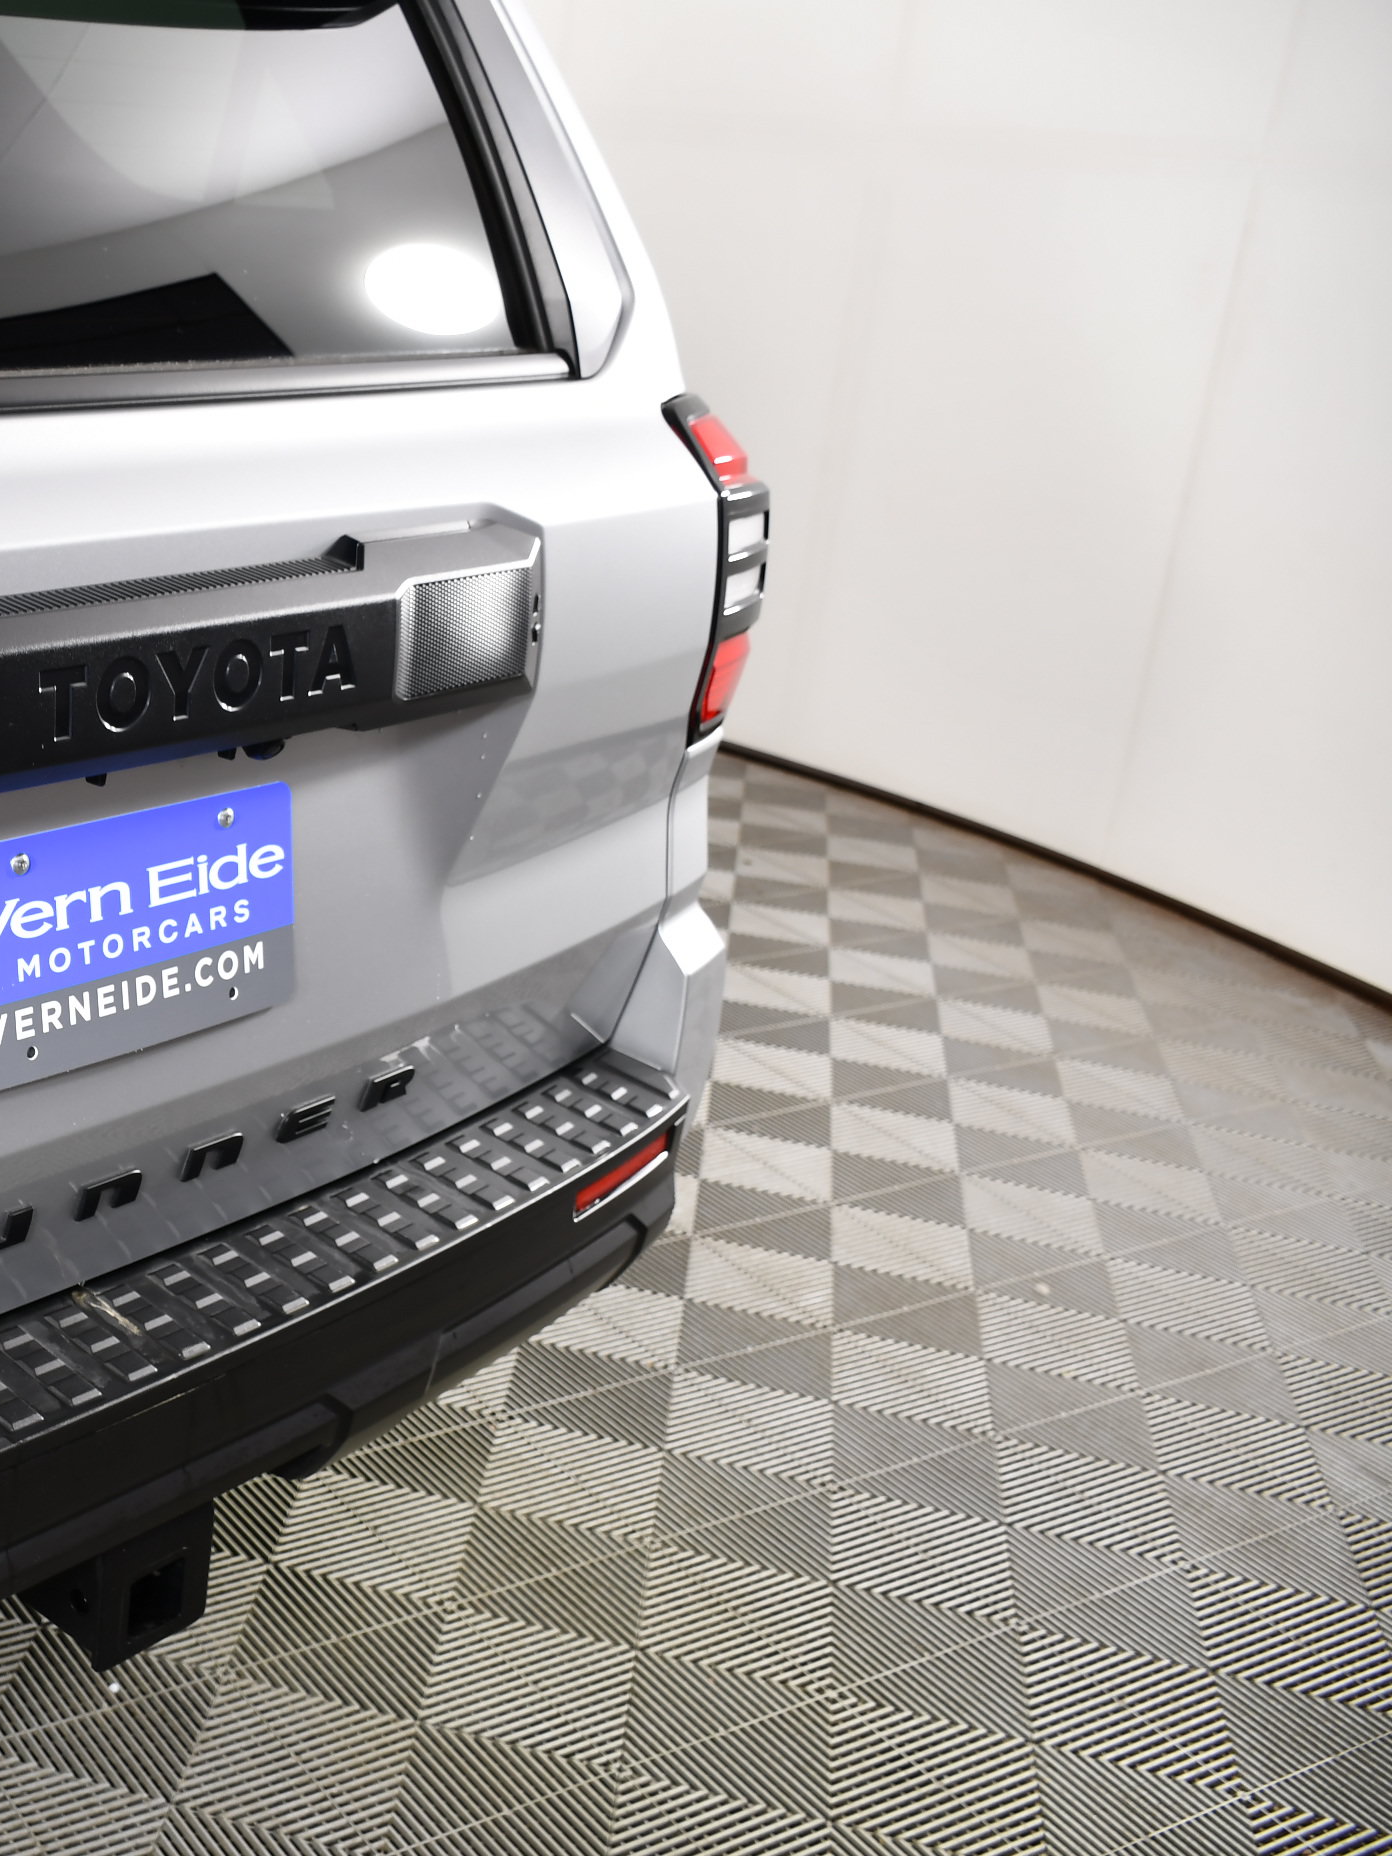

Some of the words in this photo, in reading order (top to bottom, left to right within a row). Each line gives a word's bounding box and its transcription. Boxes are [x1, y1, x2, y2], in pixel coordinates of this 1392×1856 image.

[38, 624, 357, 742] TOYOTA
[146, 843, 285, 908] Eide
[16, 898, 251, 983] MOTORCARS
